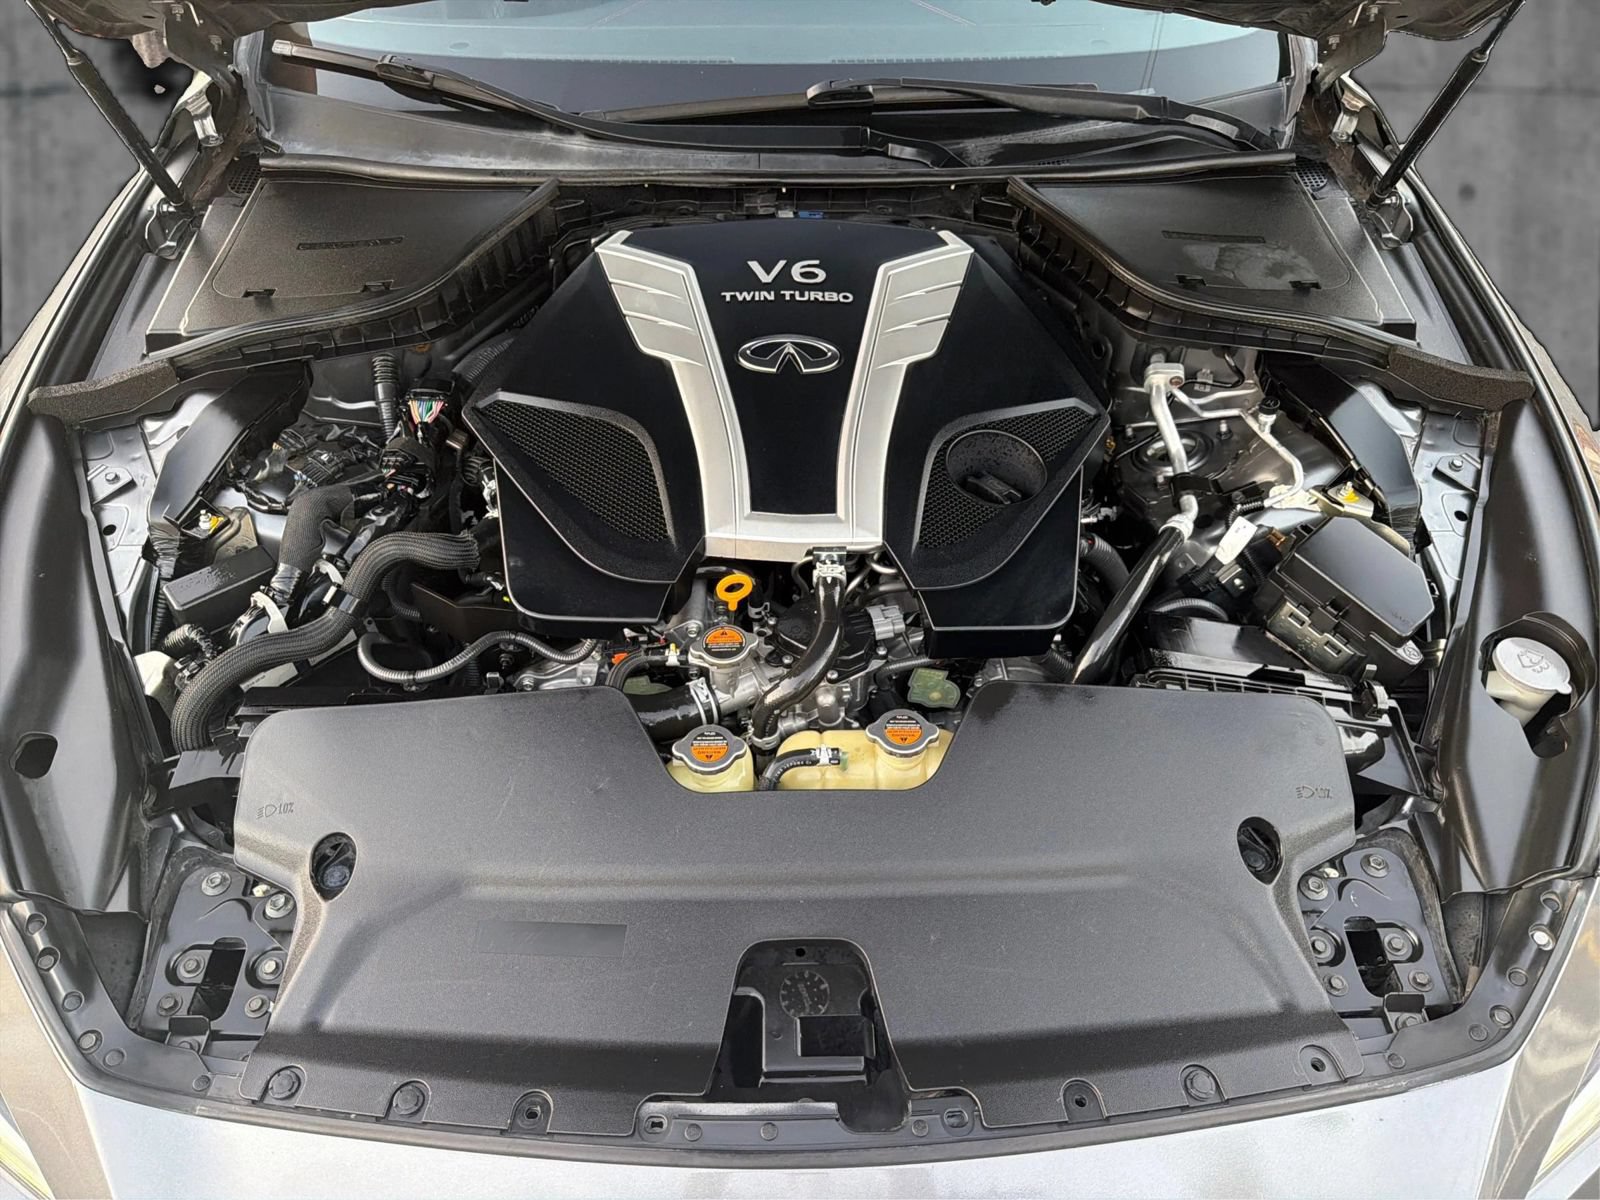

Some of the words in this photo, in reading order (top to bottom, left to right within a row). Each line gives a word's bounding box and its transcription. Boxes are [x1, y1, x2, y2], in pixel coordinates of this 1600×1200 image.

[747, 259, 827, 284] V6
[721, 291, 774, 302] TWIN
[780, 291, 854, 303] TURBO
